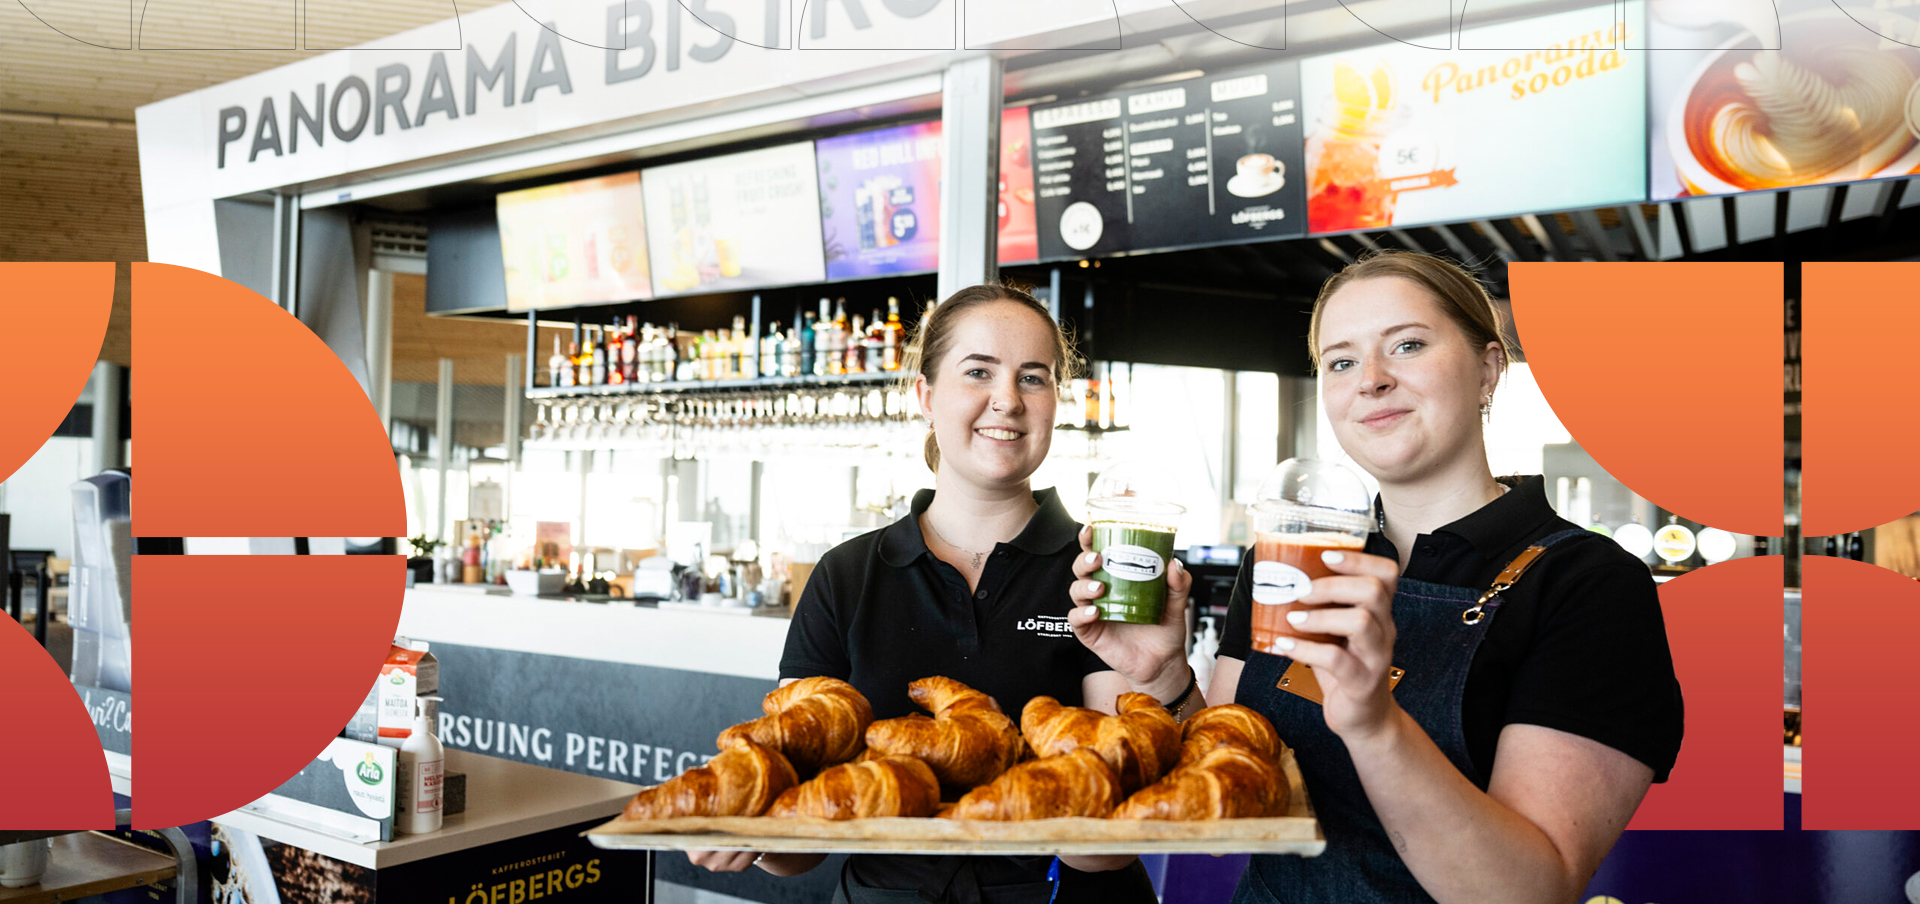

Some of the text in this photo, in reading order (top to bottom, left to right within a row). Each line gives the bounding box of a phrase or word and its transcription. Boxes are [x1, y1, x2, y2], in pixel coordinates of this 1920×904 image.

[216, 0, 944, 170] PANORAMA BIS
[1422, 21, 1633, 104] Panorama
[1510, 45, 1627, 100] sooda
[358, 762, 381, 781] Arla
[448, 858, 602, 904] ÖFBERGS
[491, 850, 567, 876] KAFFEROSTERIET
